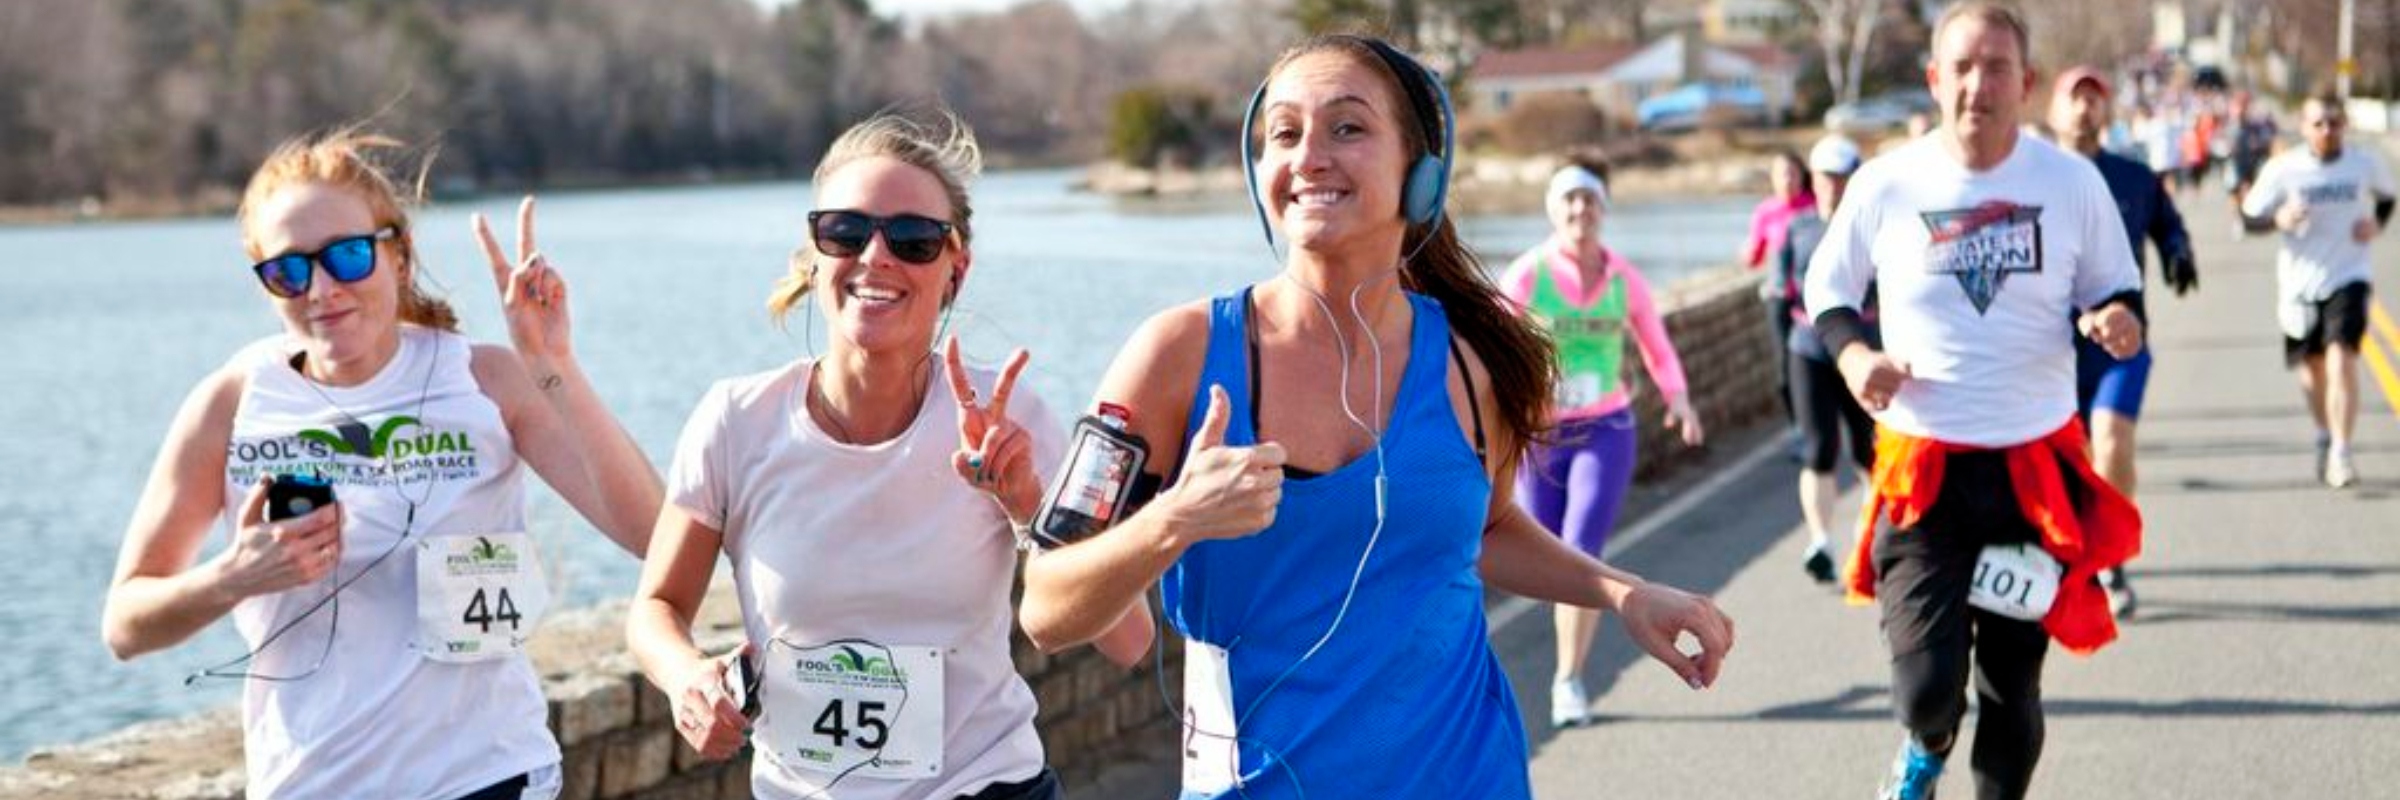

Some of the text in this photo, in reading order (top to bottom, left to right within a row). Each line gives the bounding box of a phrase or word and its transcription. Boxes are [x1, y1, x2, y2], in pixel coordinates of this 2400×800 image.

[393, 431, 476, 459] DUAL
[437, 455, 476, 468] RACE
[1974, 561, 2033, 608] 101
[463, 587, 523, 634] 44
[812, 698, 890, 750] 45
